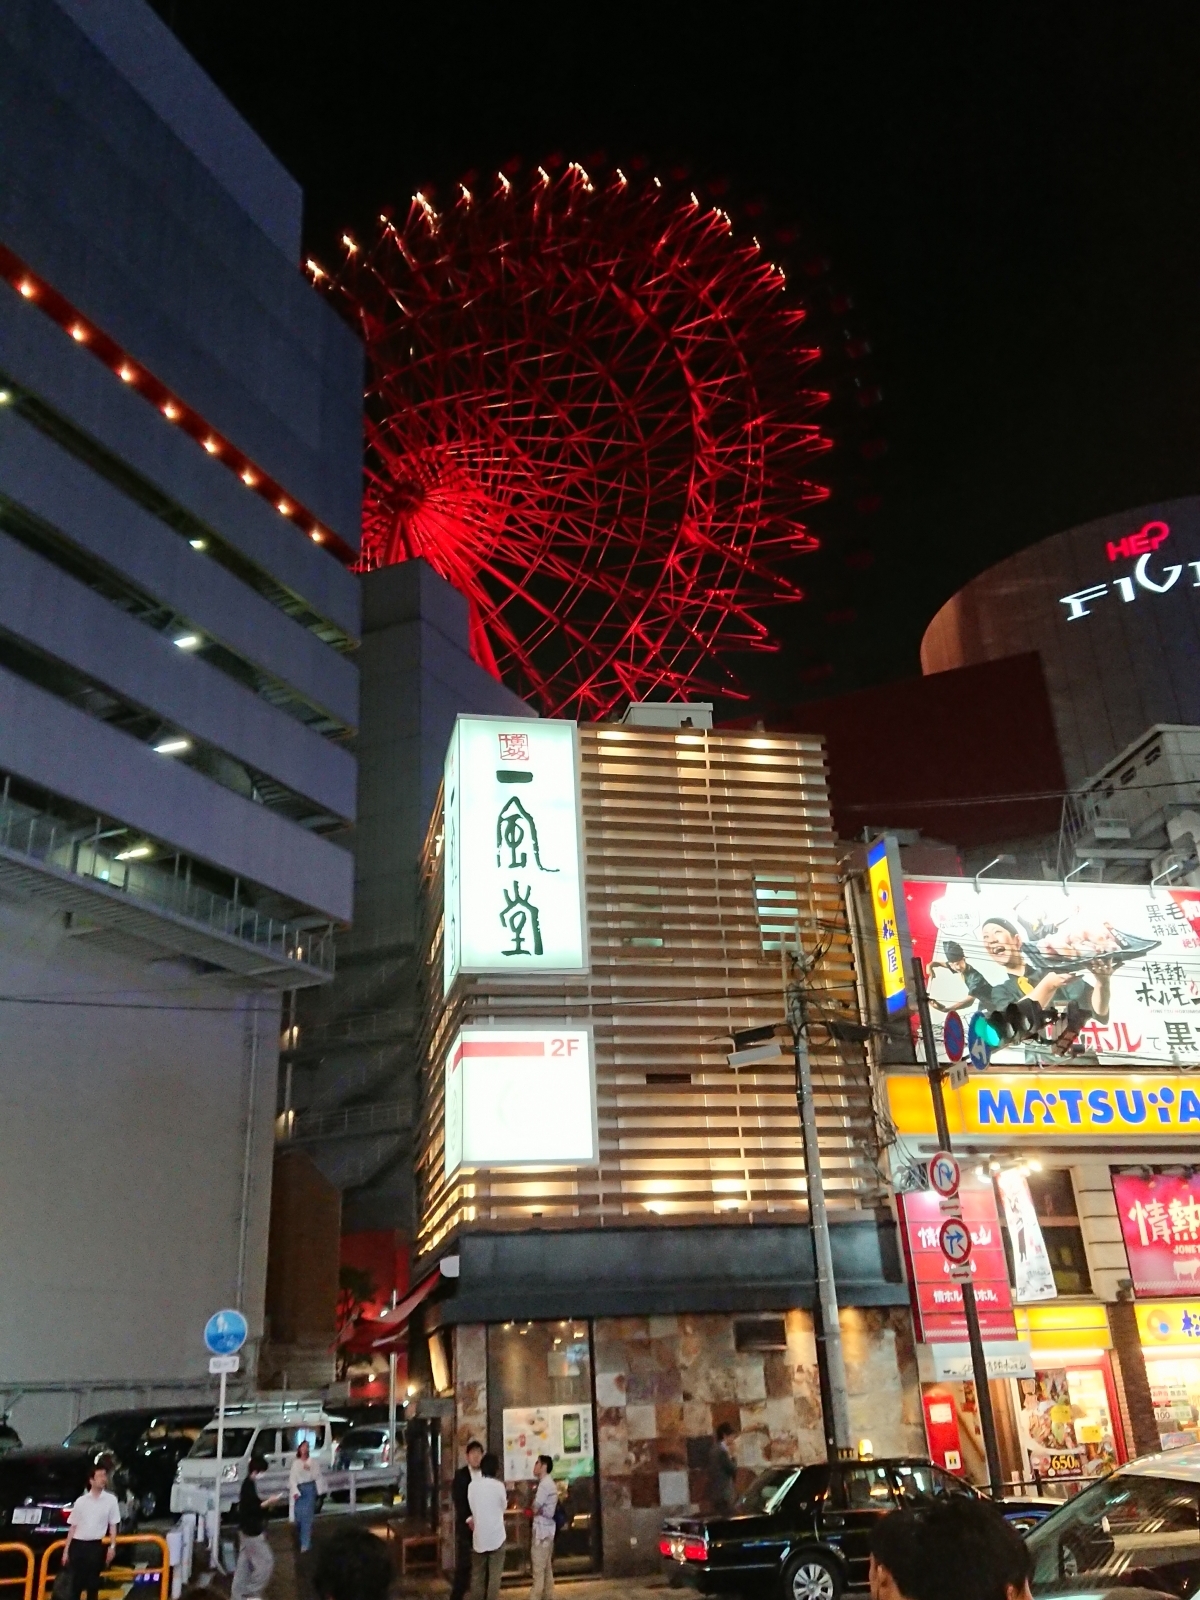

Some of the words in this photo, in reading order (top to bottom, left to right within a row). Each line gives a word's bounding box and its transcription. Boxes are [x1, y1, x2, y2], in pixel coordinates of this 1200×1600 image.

[1107, 521, 1170, 562] HEP
[496, 769, 560, 956] 一風堂
[882, 918, 899, 973] 松屋
[1142, 961, 1187, 986] 情熱
[551, 1039, 579, 1057] 2F
